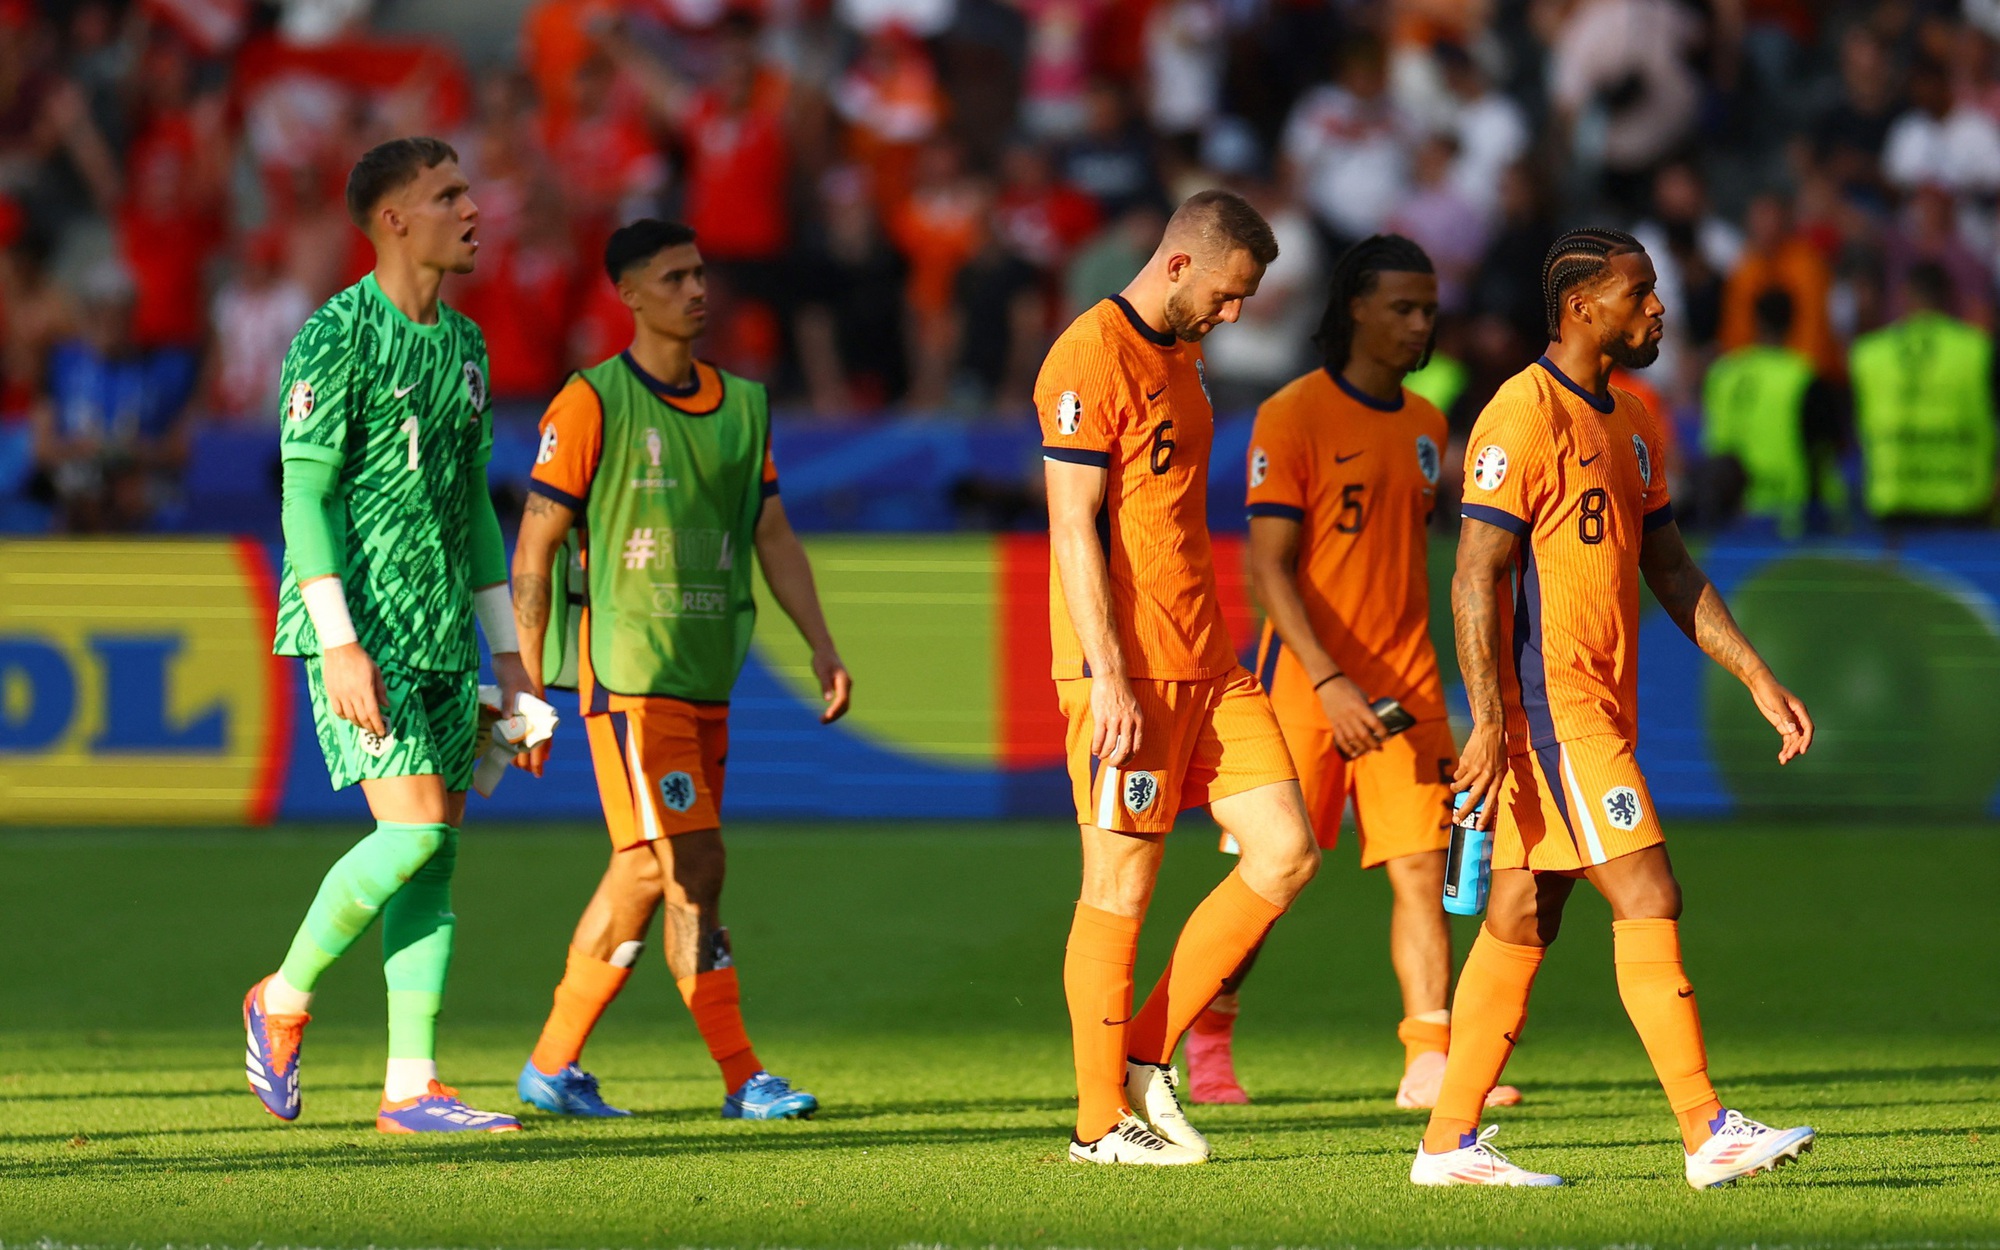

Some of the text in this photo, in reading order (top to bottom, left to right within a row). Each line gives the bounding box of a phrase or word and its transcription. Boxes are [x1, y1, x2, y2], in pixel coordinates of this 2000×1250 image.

[400, 415, 418, 471] 1
[1151, 419, 1175, 475] 6
[1337, 484, 1364, 534] 5
[1579, 487, 1606, 545] 8
